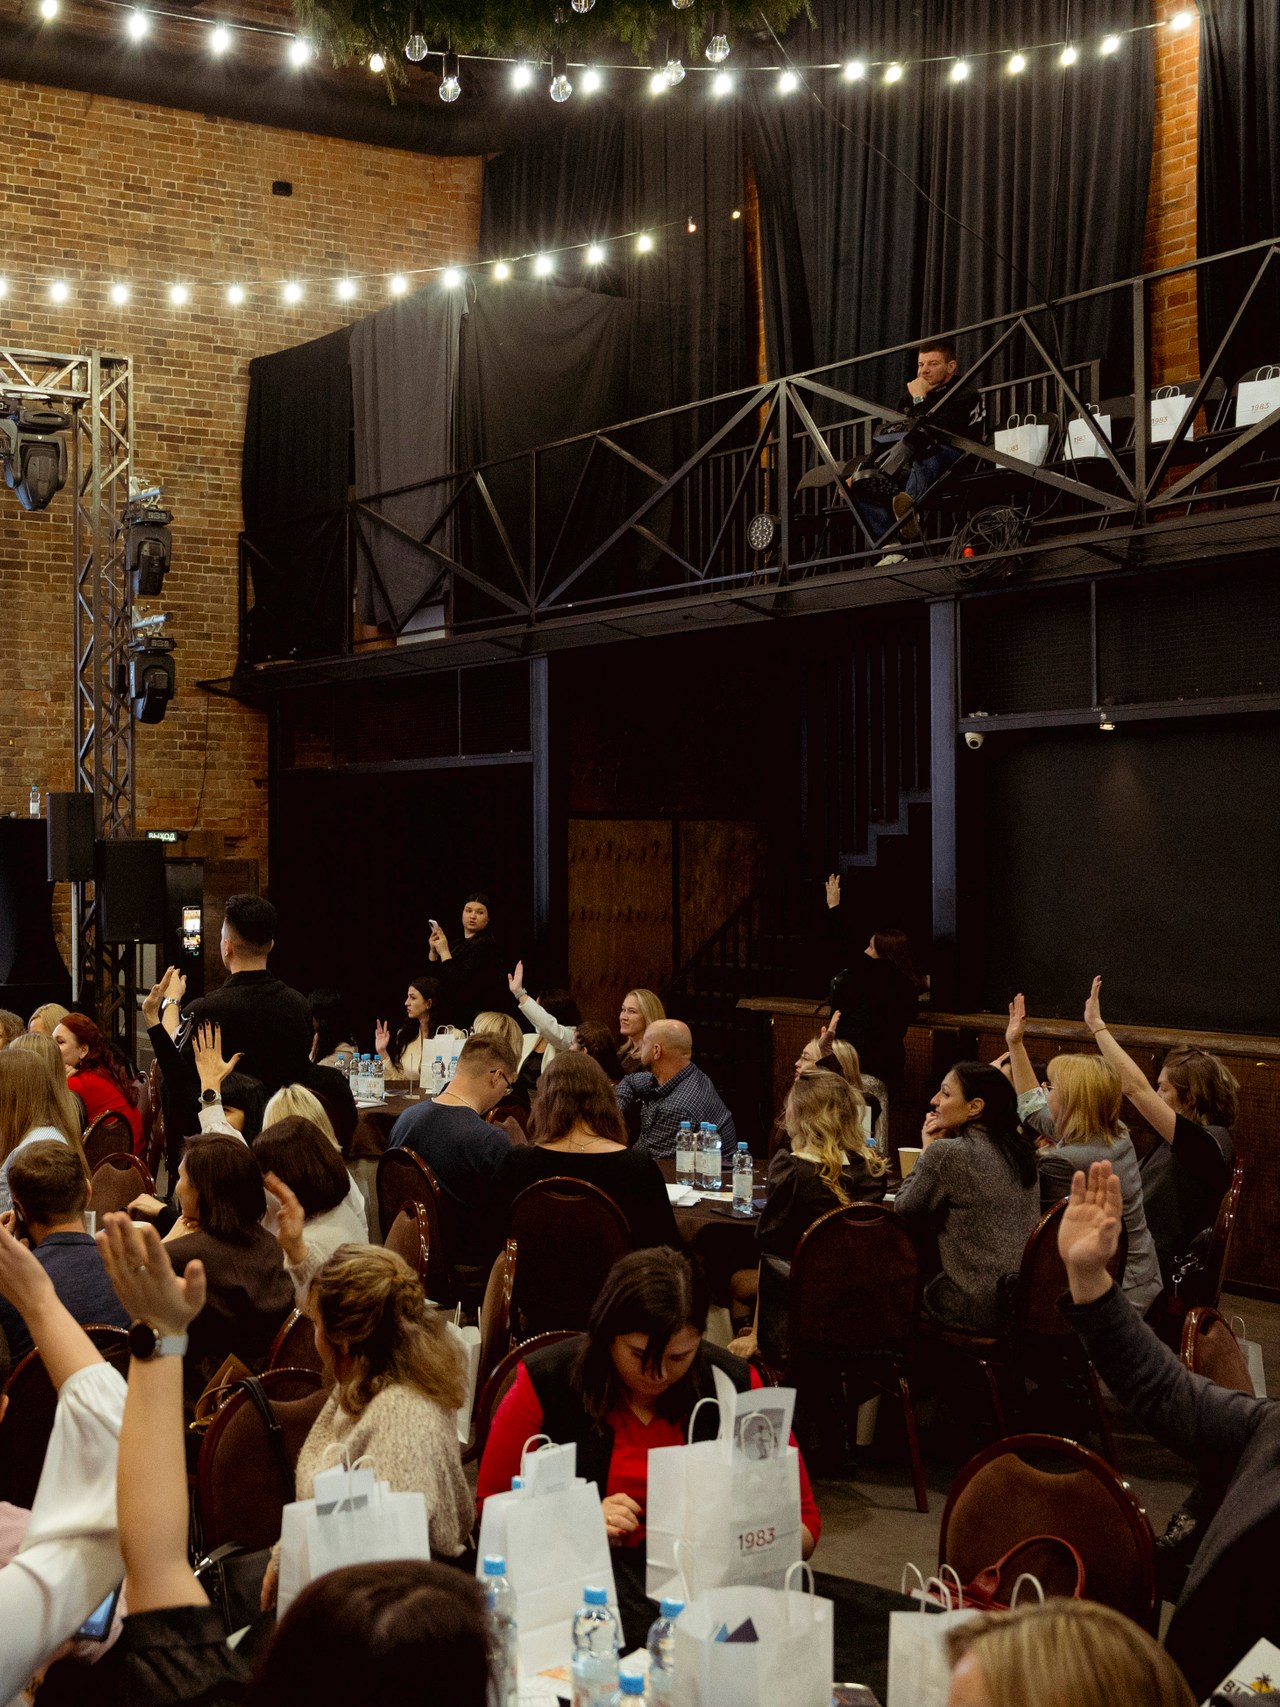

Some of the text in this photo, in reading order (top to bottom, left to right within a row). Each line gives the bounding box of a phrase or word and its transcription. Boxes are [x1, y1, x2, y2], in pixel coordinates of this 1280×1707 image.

[1250, 402, 1270, 414] 1983
[1151, 415, 1168, 425] 1983
[148, 832, 176, 842] ВЫХОД
[738, 1527, 776, 1550] 1983
